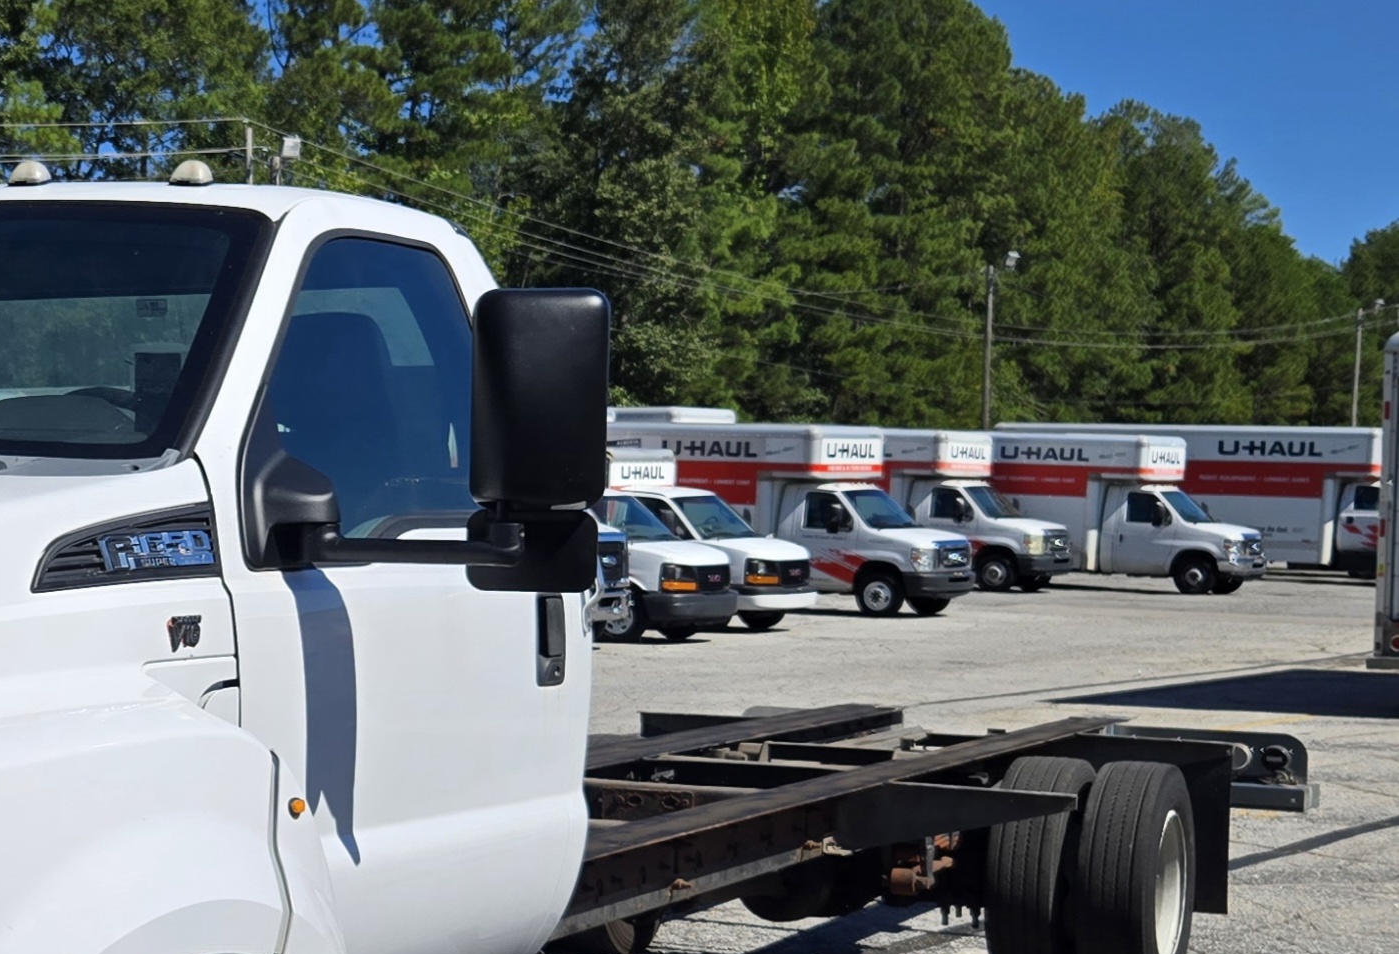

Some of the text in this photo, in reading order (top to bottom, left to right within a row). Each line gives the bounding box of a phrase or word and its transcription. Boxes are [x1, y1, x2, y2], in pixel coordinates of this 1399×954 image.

[662, 440, 757, 458] U-HAUL
[827, 443, 875, 459] U-HAUL
[951, 446, 986, 460] U-HAUL
[1001, 446, 1089, 462] U-HAUL
[1218, 440, 1323, 457] U-HAUL
[1151, 451, 1181, 465] U-HAUL
[621, 466, 665, 480] U-HAUL
[141, 557, 179, 568] SUPER
